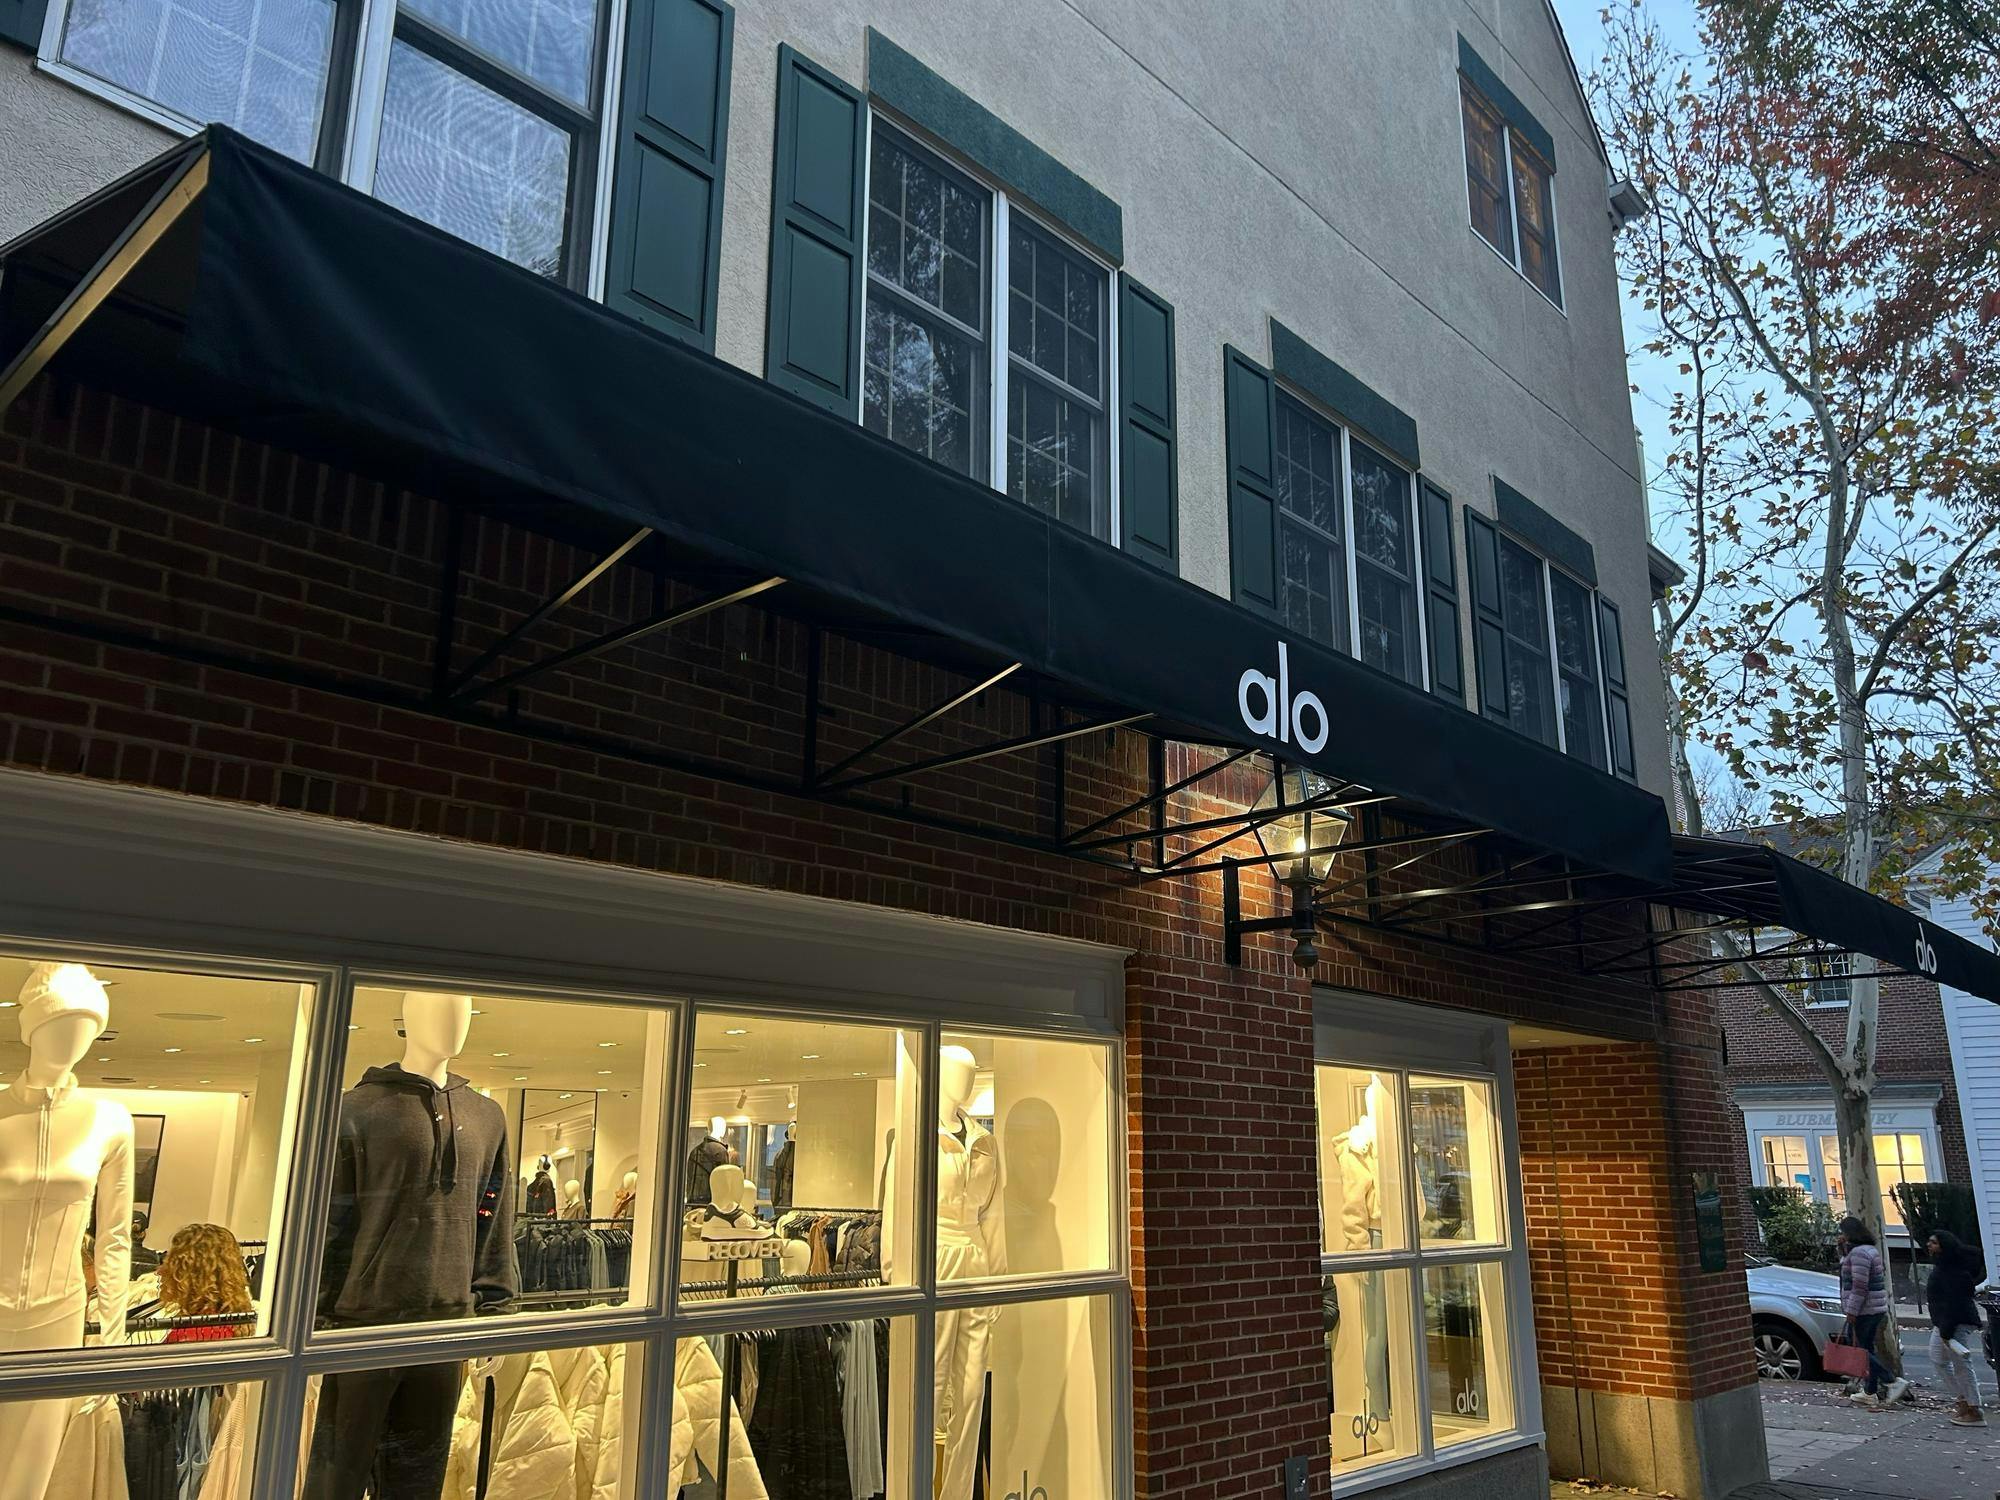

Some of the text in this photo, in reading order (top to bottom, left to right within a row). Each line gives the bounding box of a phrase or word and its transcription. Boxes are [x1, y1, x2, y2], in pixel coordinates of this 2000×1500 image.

[1238, 641, 1329, 754] alo
[1915, 922, 1937, 975] alo
[708, 1239, 792, 1260] RECOVERY
[1456, 1377, 1480, 1414] alo
